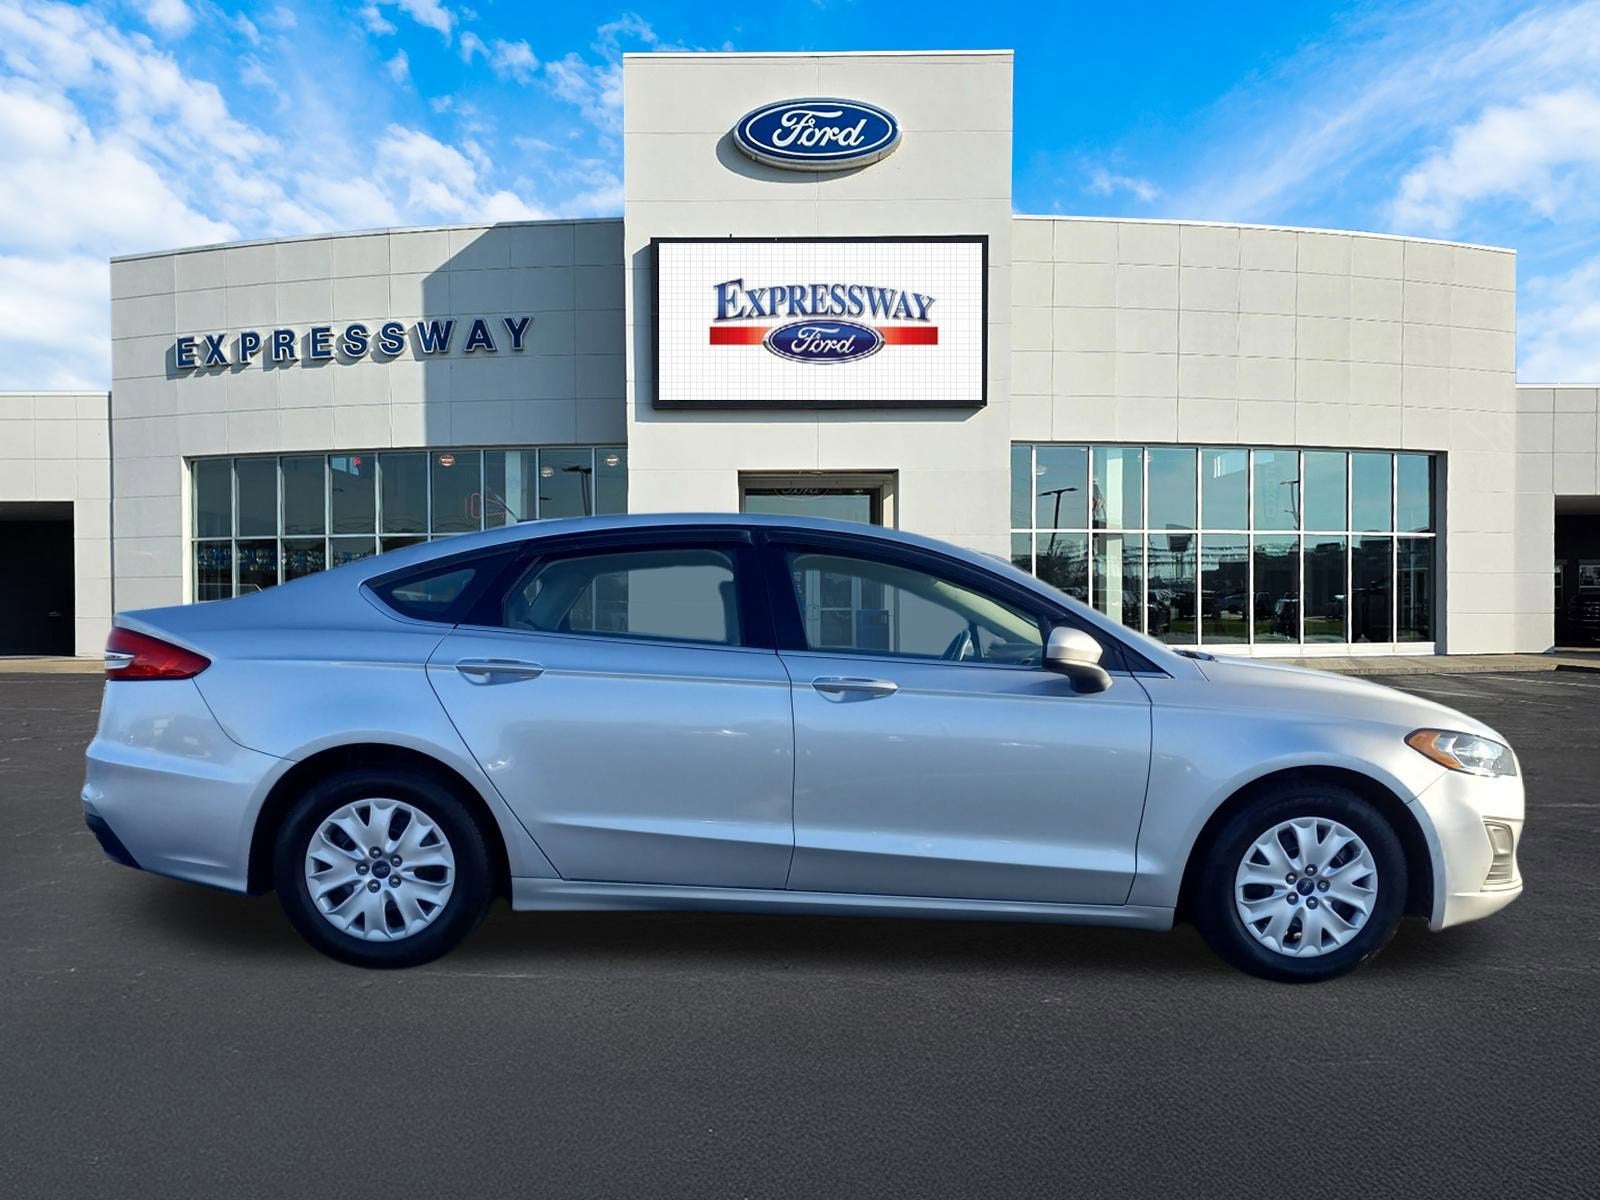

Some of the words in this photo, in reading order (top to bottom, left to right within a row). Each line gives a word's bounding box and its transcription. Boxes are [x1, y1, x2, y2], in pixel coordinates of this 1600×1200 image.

[772, 109, 865, 148] Ford
[175, 316, 532, 369] EXPRESSWAY
[791, 326, 856, 354] Ford
